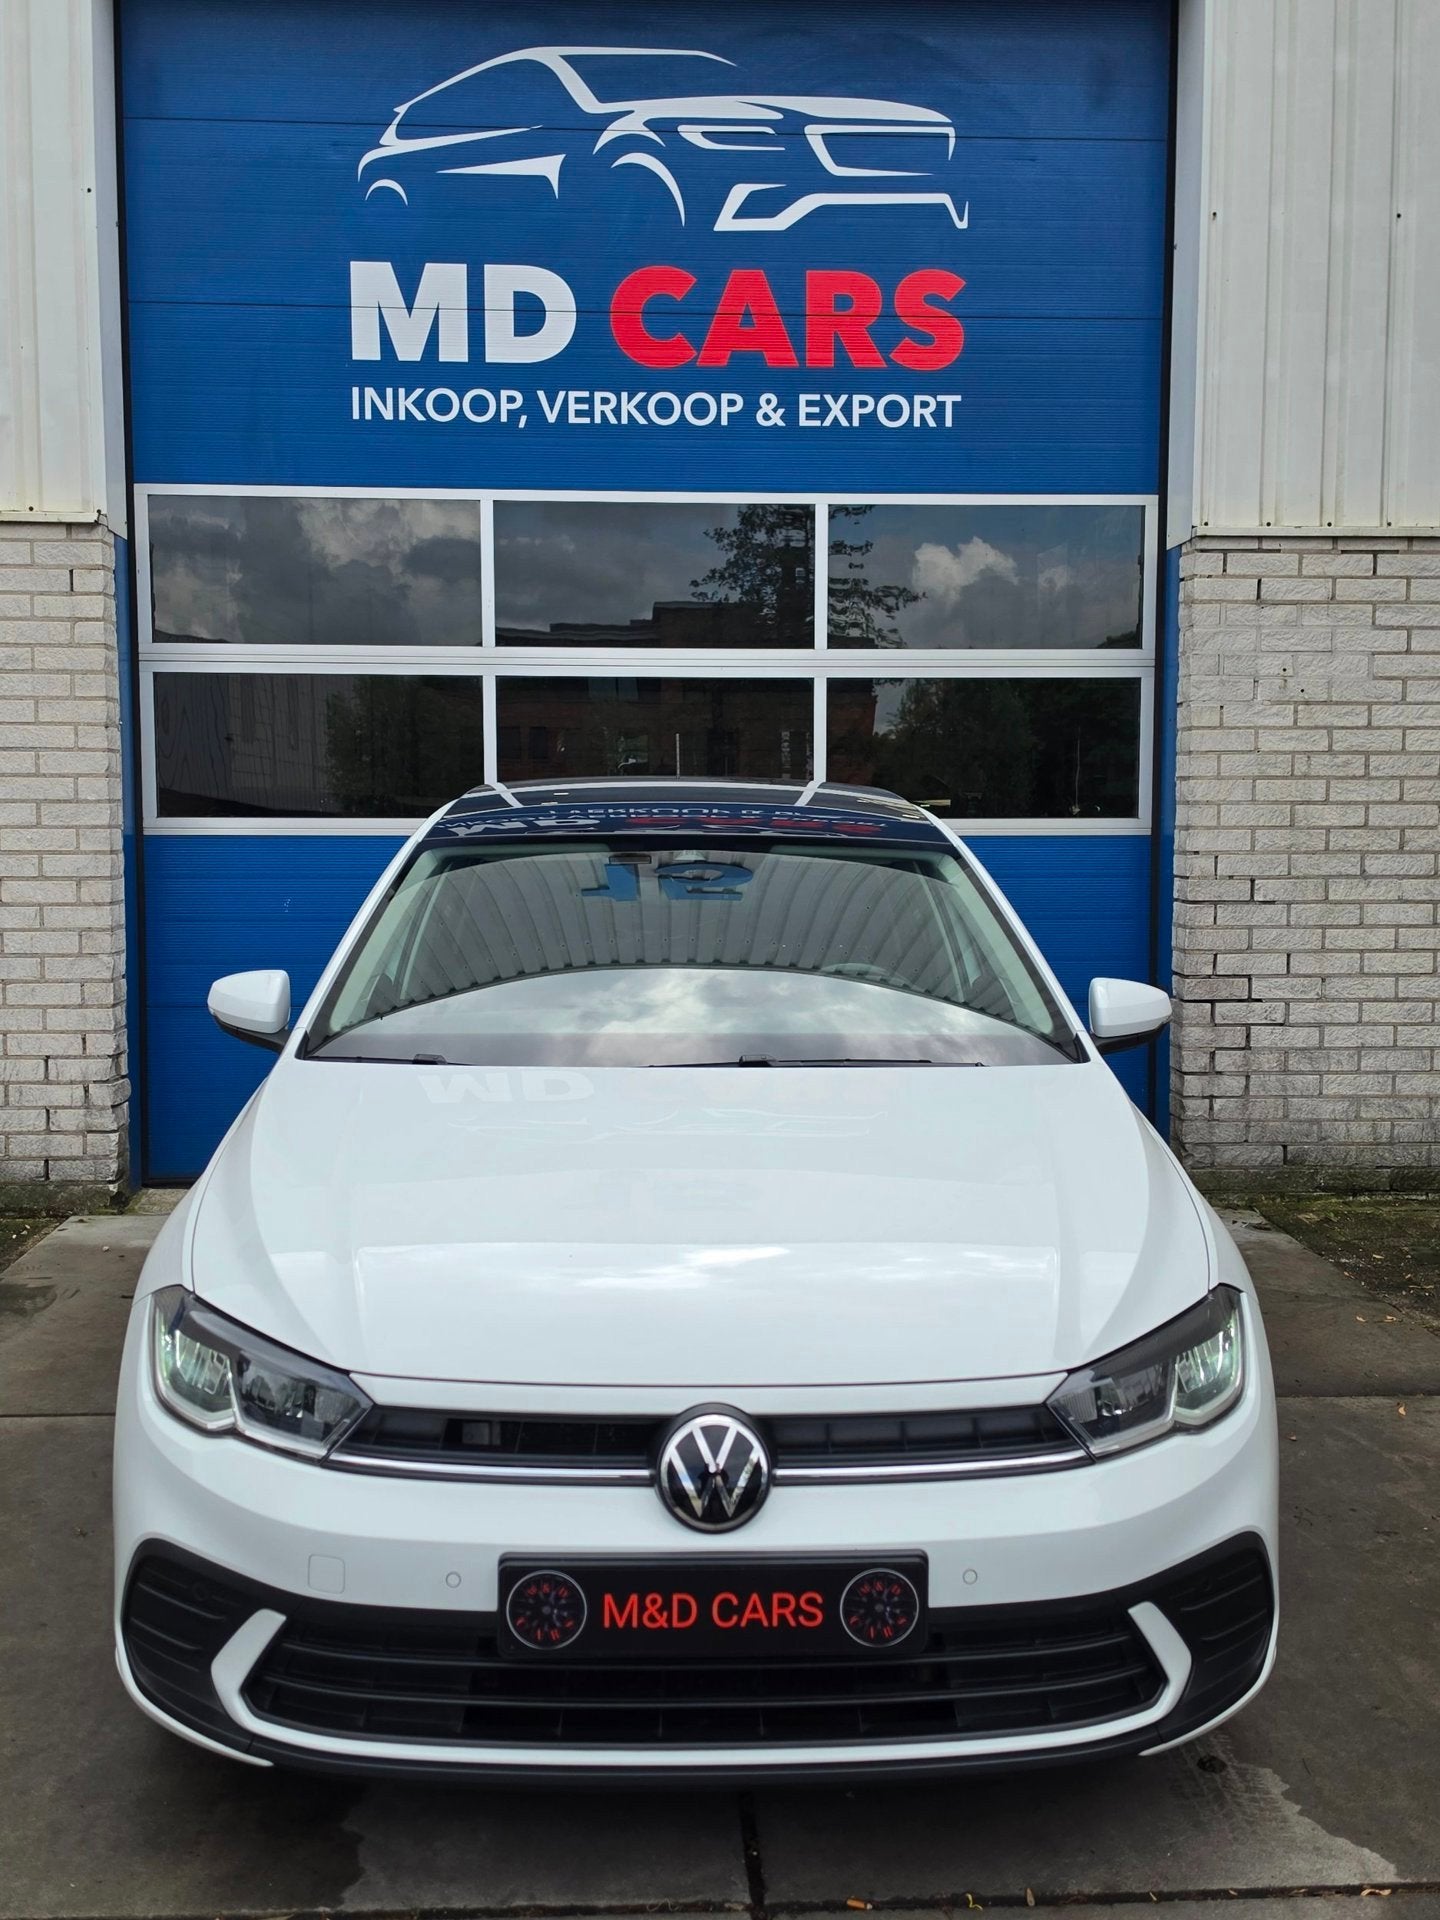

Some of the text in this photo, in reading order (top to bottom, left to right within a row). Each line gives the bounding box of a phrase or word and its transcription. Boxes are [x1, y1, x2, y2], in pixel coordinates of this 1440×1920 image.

[350, 261, 967, 371] MD CARS
[352, 387, 962, 428] INKOOP, VERKOOP & EXPORT
[604, 1593, 698, 1629] M&D
[712, 1592, 824, 1629] CARS
